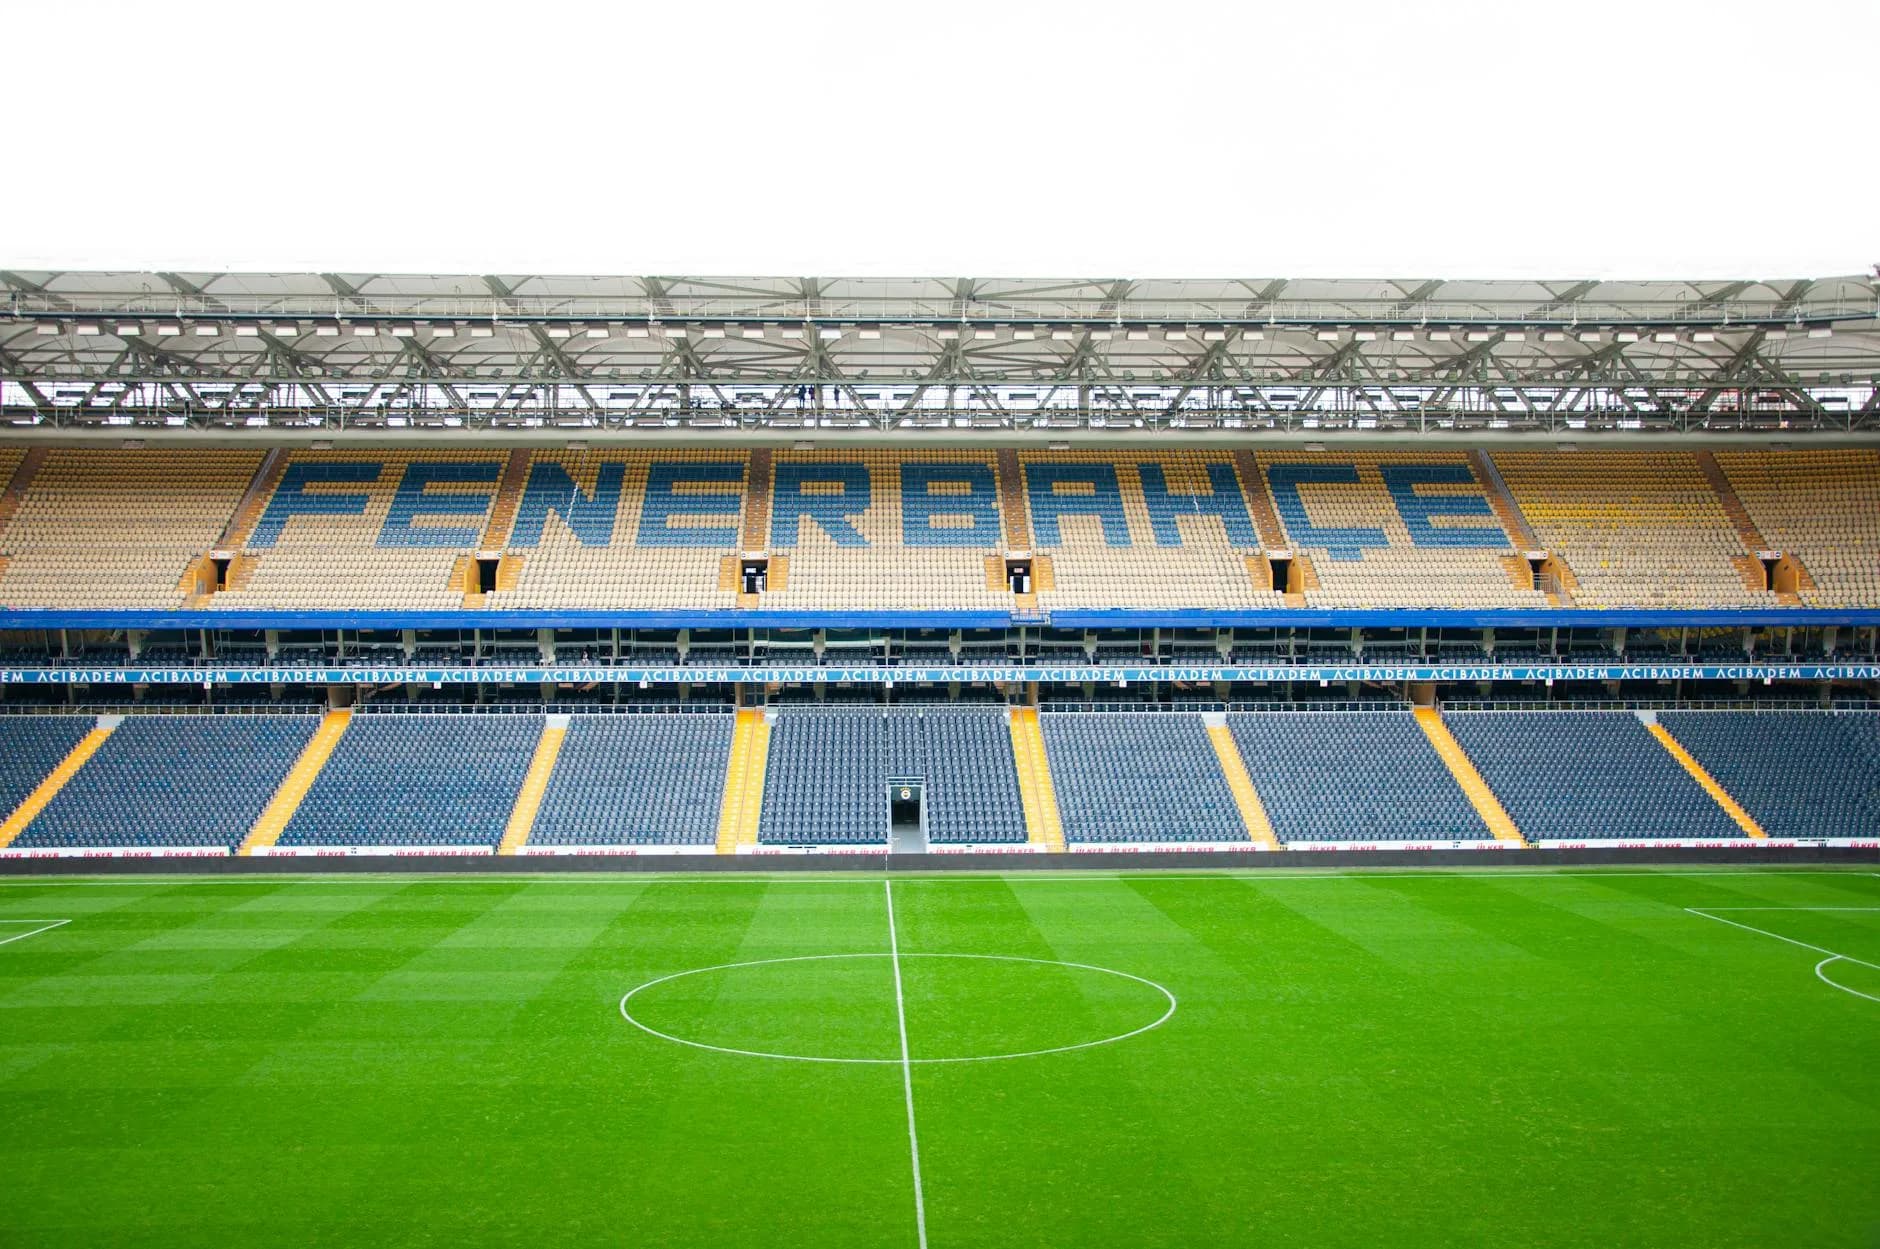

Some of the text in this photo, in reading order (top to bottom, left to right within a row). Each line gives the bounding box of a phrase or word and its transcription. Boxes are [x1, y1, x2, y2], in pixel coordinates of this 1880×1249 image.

[247, 462, 1513, 562] FENERBAHÇE
[37, 672, 126, 682] ACIBADEM
[139, 672, 227, 682] ACIBADEM
[241, 672, 327, 682] ACIBADEM
[340, 672, 427, 682] ACIBADEM
[441, 672, 527, 681] ACIBADEM
[542, 671, 628, 681] ACIBADEM
[641, 671, 728, 681] ACIBADEM
[741, 671, 827, 681] ACIBADEM
[842, 670, 926, 680] ACIBADEM
[940, 670, 1025, 680] ACIBADEM
[1039, 670, 1124, 680] ACIBADEM
[1137, 670, 1222, 680] ACIBADEM
[1236, 670, 1320, 680] ACIBADEM
[1333, 670, 1416, 679] ACIBADEM
[1430, 669, 1512, 679] ACIBADEM
[1526, 669, 1608, 679] ACIBADEM
[1620, 668, 1703, 678] ACIBADEM
[1716, 668, 1800, 678] ACIBADEM
